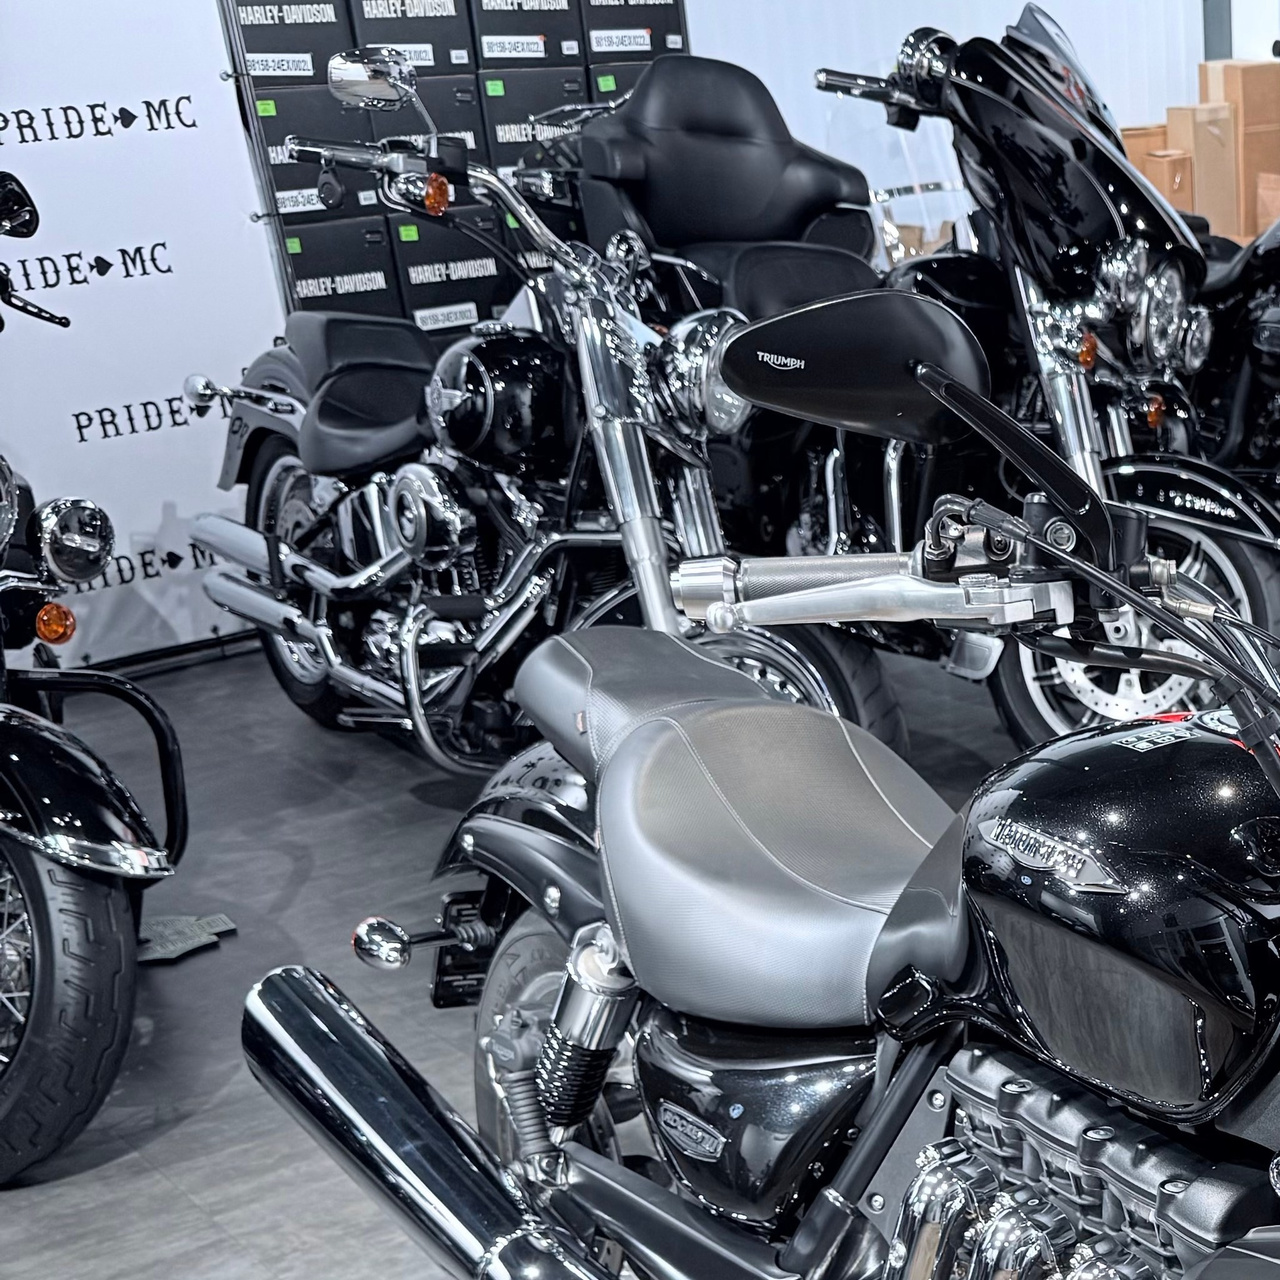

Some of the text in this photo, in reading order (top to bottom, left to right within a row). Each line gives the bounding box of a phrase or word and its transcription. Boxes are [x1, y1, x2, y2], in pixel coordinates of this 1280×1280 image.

[238, 4, 338, 25] HARLEY-DAVIDSON
[362, 0, 457, 18] HARLEY-DAVIDSON
[141, 96, 198, 132] MC
[117, 241, 173, 278] MC
[407, 257, 498, 285] HARLEY-DAVIDSON
[757, 351, 805, 370] TRIUMPH
[71, 395, 190, 443] PRIDE
